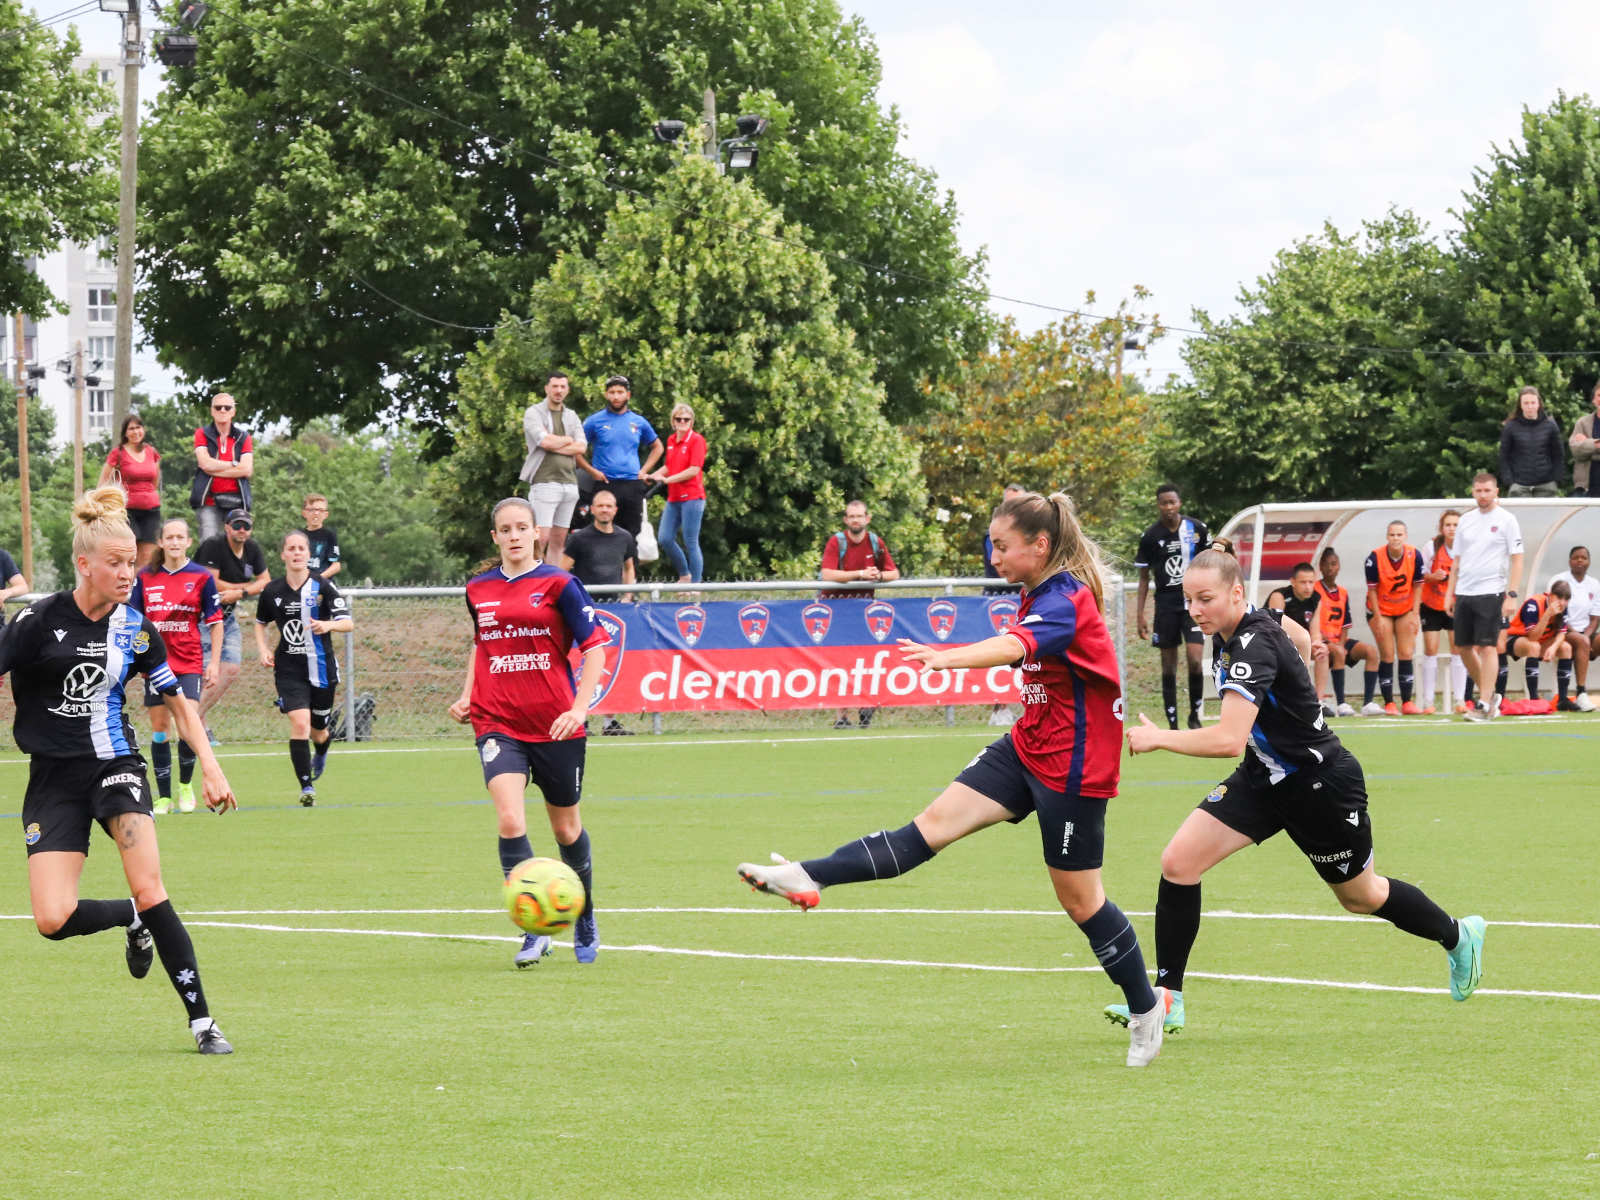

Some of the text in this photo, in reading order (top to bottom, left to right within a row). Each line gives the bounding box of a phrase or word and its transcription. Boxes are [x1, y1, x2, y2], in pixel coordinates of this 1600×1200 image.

[480, 628, 503, 641] rédit
[502, 653, 550, 664] CLERMONT
[502, 661, 551, 673] FERRAND
[101, 772, 142, 788] AUXERRE
[1063, 821, 1071, 847] PATRICK
[1309, 849, 1354, 863] AUXERRE
